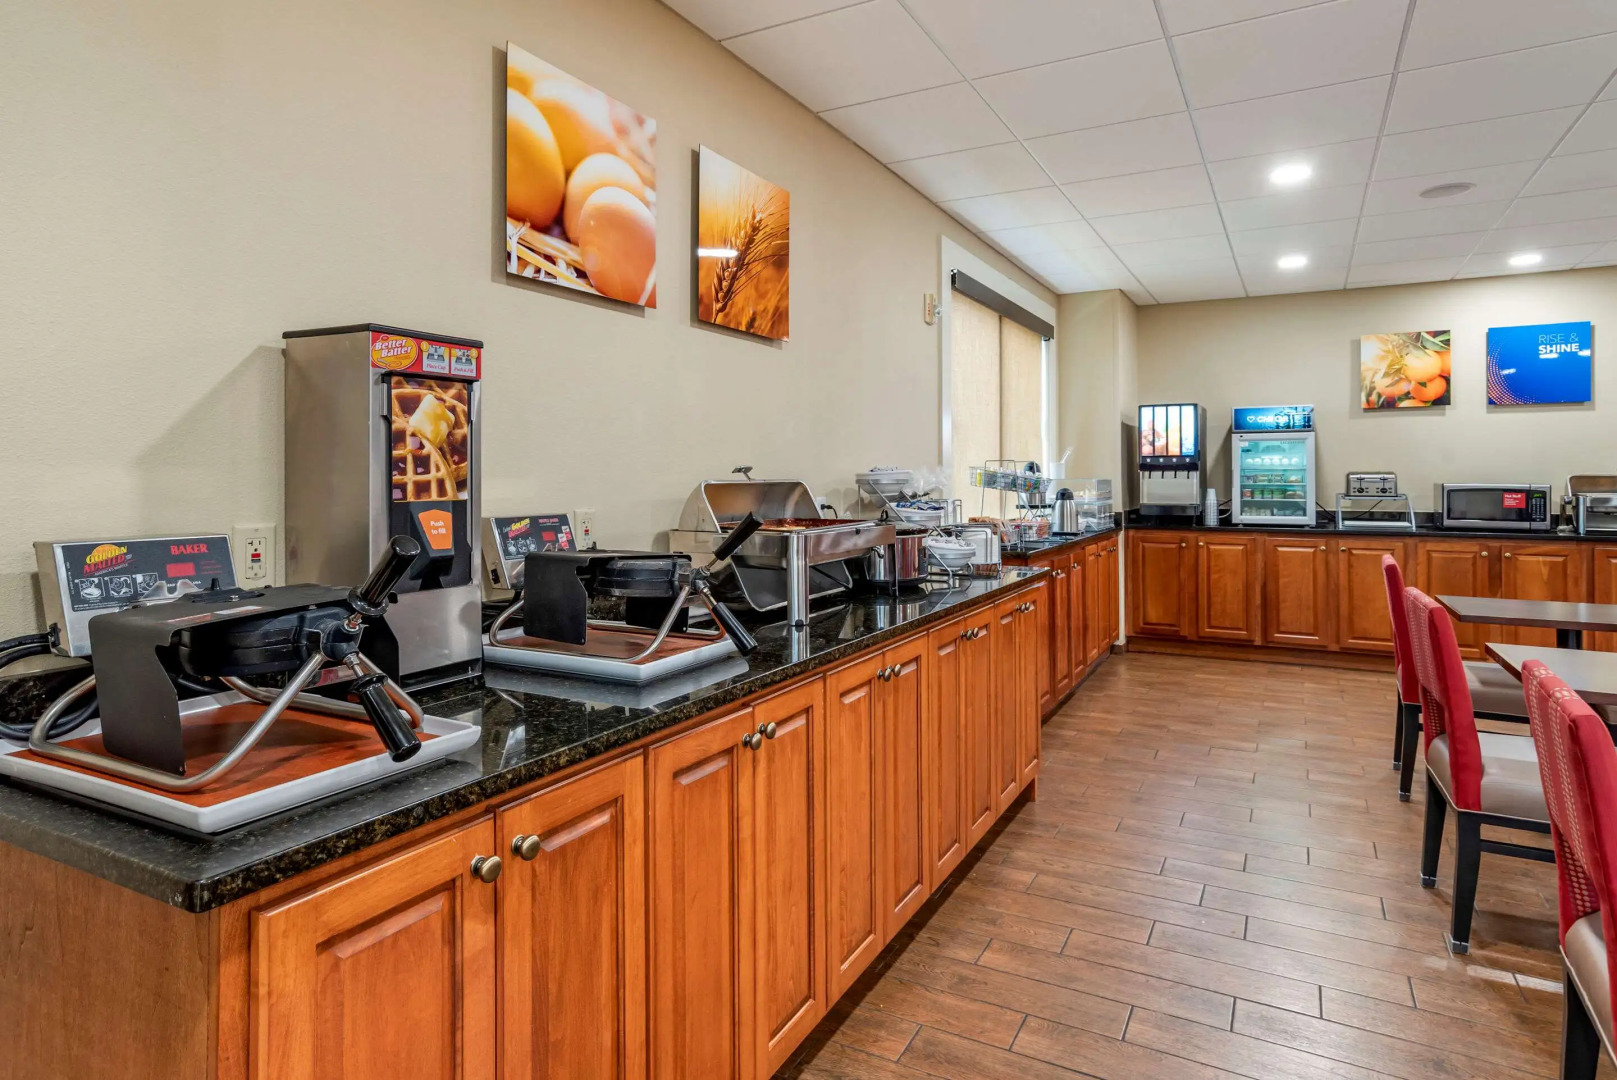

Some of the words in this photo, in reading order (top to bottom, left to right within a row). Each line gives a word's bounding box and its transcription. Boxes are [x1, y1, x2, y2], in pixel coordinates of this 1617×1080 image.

[1538, 333, 1565, 344] RISE
[1569, 332, 1579, 342] &
[374, 339, 407, 351] Better
[1538, 343, 1580, 354] SHINE
[381, 346, 412, 358] Batter
[85, 545, 128, 564] GOLDEN
[170, 543, 208, 556] BAKER
[83, 554, 126, 574] MALTED
